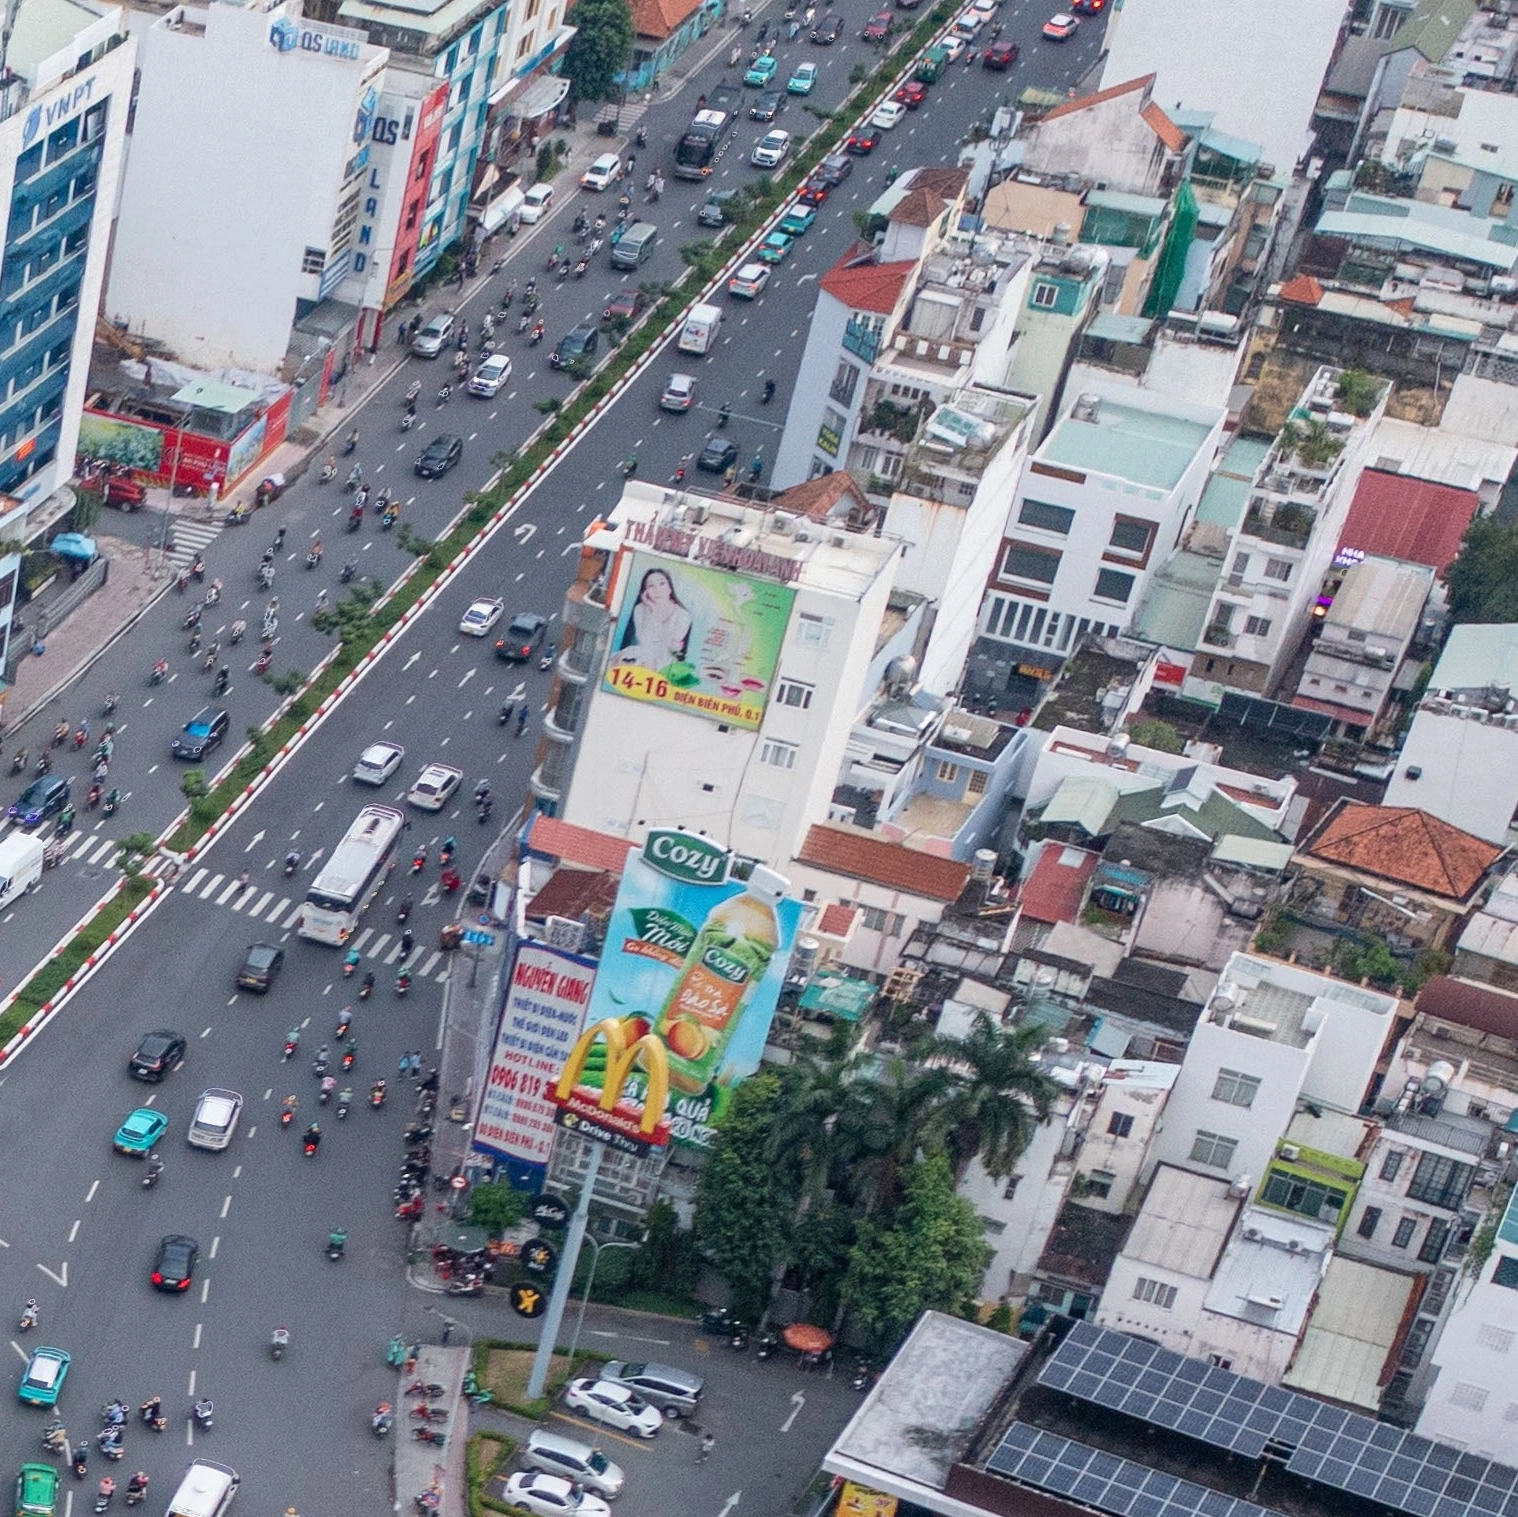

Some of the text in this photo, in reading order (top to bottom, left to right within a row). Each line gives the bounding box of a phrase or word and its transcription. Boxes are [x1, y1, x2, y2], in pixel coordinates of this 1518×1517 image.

[45, 76, 96, 126] VNPT
[612, 668, 669, 699] 14-16
[697, 694, 720, 711] BIÊN
[652, 836, 722, 879] Cozy
[703, 949, 747, 981] Cozy
[555, 974, 590, 1005] GIANG
[503, 1049, 561, 1075] HOTLINE:
[489, 1064, 542, 1097] 0906 819
[577, 1120, 639, 1152] Drive Thru
